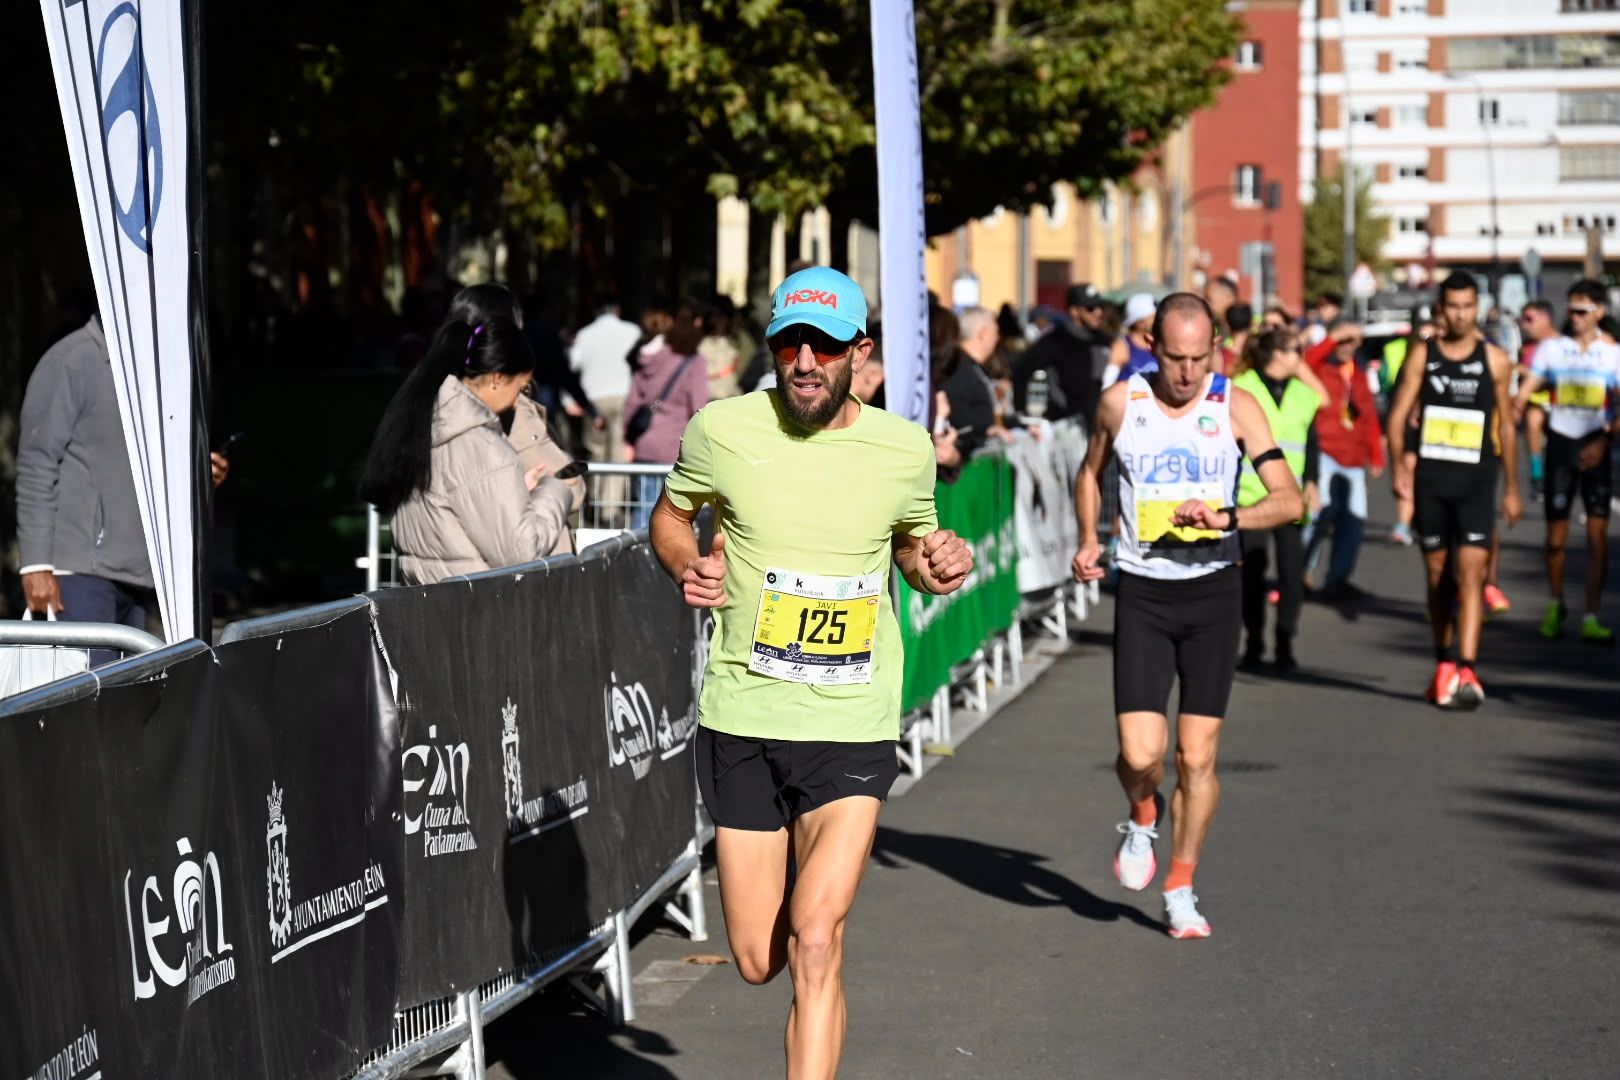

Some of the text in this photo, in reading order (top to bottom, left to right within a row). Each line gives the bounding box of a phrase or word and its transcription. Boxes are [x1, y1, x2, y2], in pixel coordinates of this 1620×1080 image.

[784, 289, 838, 309] HOKA
[1124, 446, 1226, 481] arregui
[816, 601, 837, 610] JAVI
[797, 608, 848, 645] 125
[425, 803, 450, 828] Cuna
[294, 879, 364, 934] AYUNTAMIENTO
[74, 1023, 99, 1073] LEÓN
